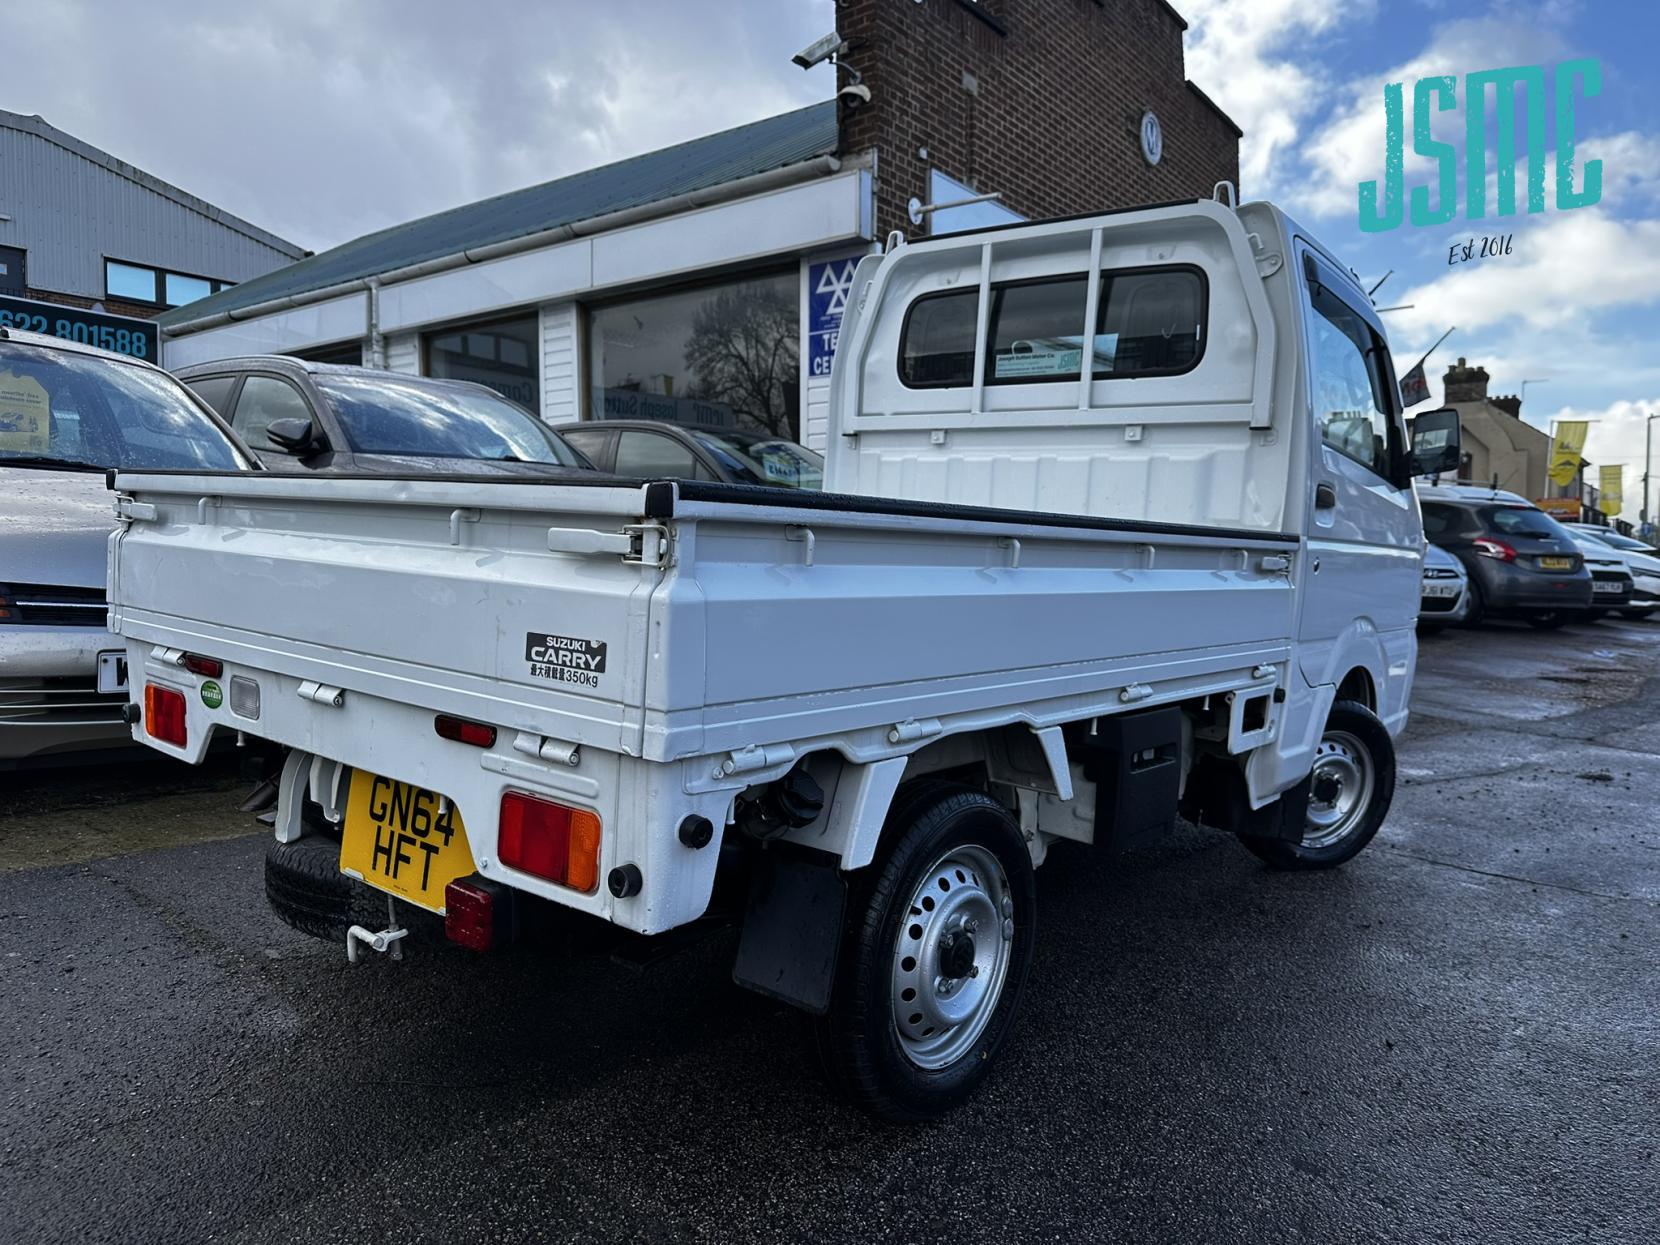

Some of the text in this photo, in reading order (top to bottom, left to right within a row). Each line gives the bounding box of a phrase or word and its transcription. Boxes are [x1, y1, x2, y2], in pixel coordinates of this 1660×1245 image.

[55, 319, 147, 357] 801588
[531, 646, 602, 670] CARRY
[546, 636, 586, 651] SUZUKI
[369, 775, 456, 847] GN64
[371, 824, 440, 892] HFT
